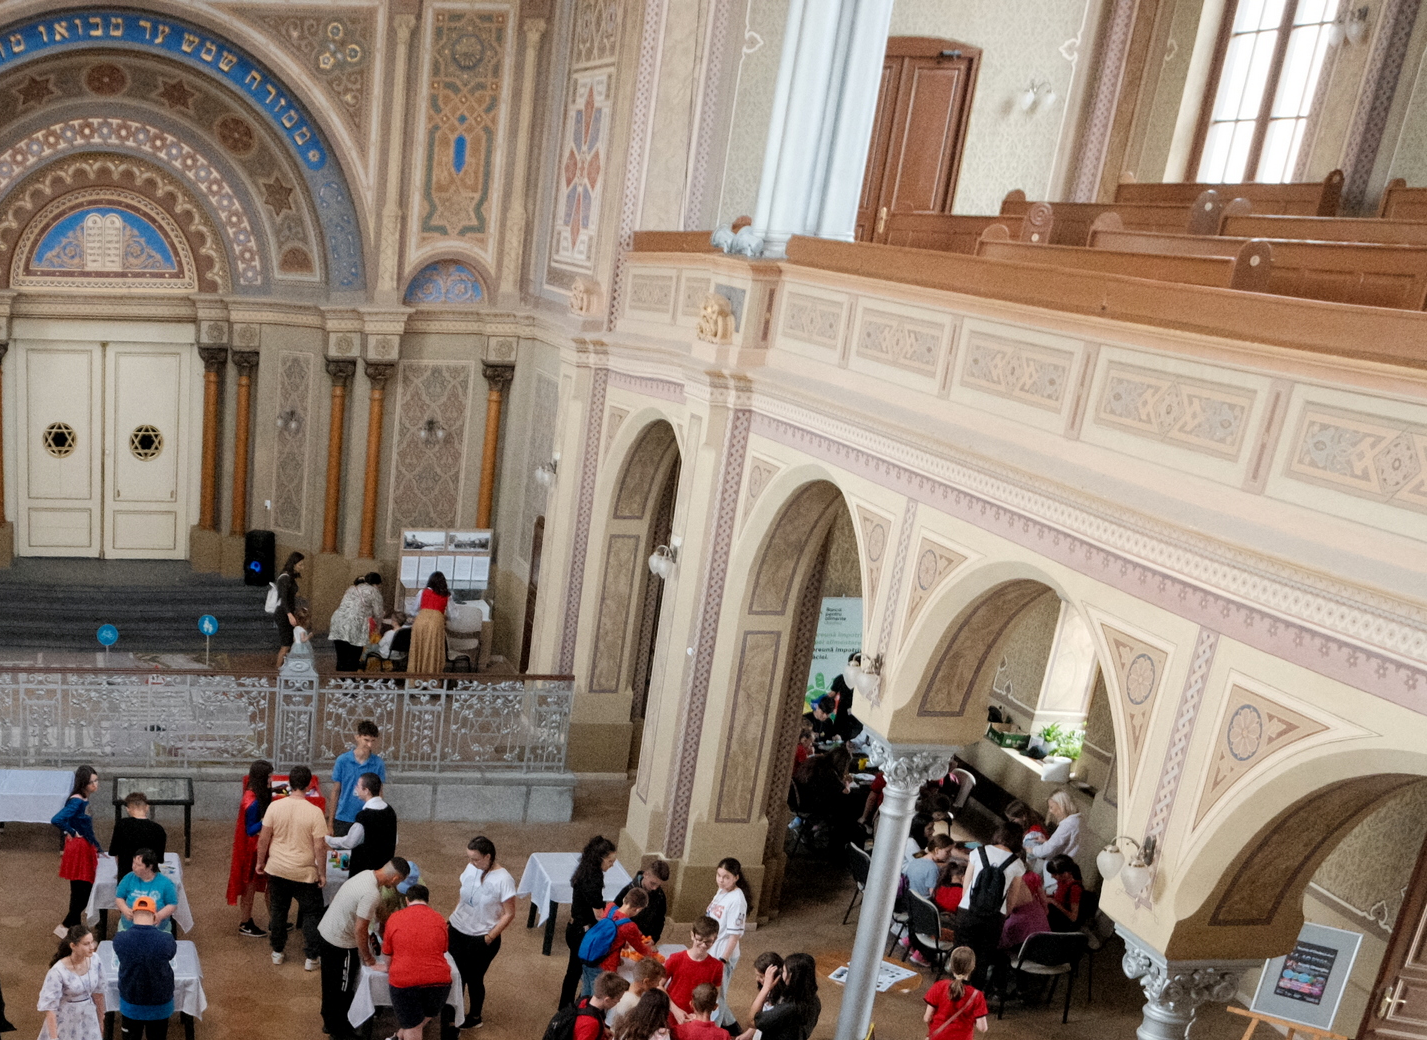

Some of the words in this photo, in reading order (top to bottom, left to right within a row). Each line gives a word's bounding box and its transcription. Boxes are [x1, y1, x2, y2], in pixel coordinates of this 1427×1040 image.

[37, 16, 124, 43] מבואו
[181, 32, 238, 72] שמש
[244, 70, 311, 146] ממזרח
